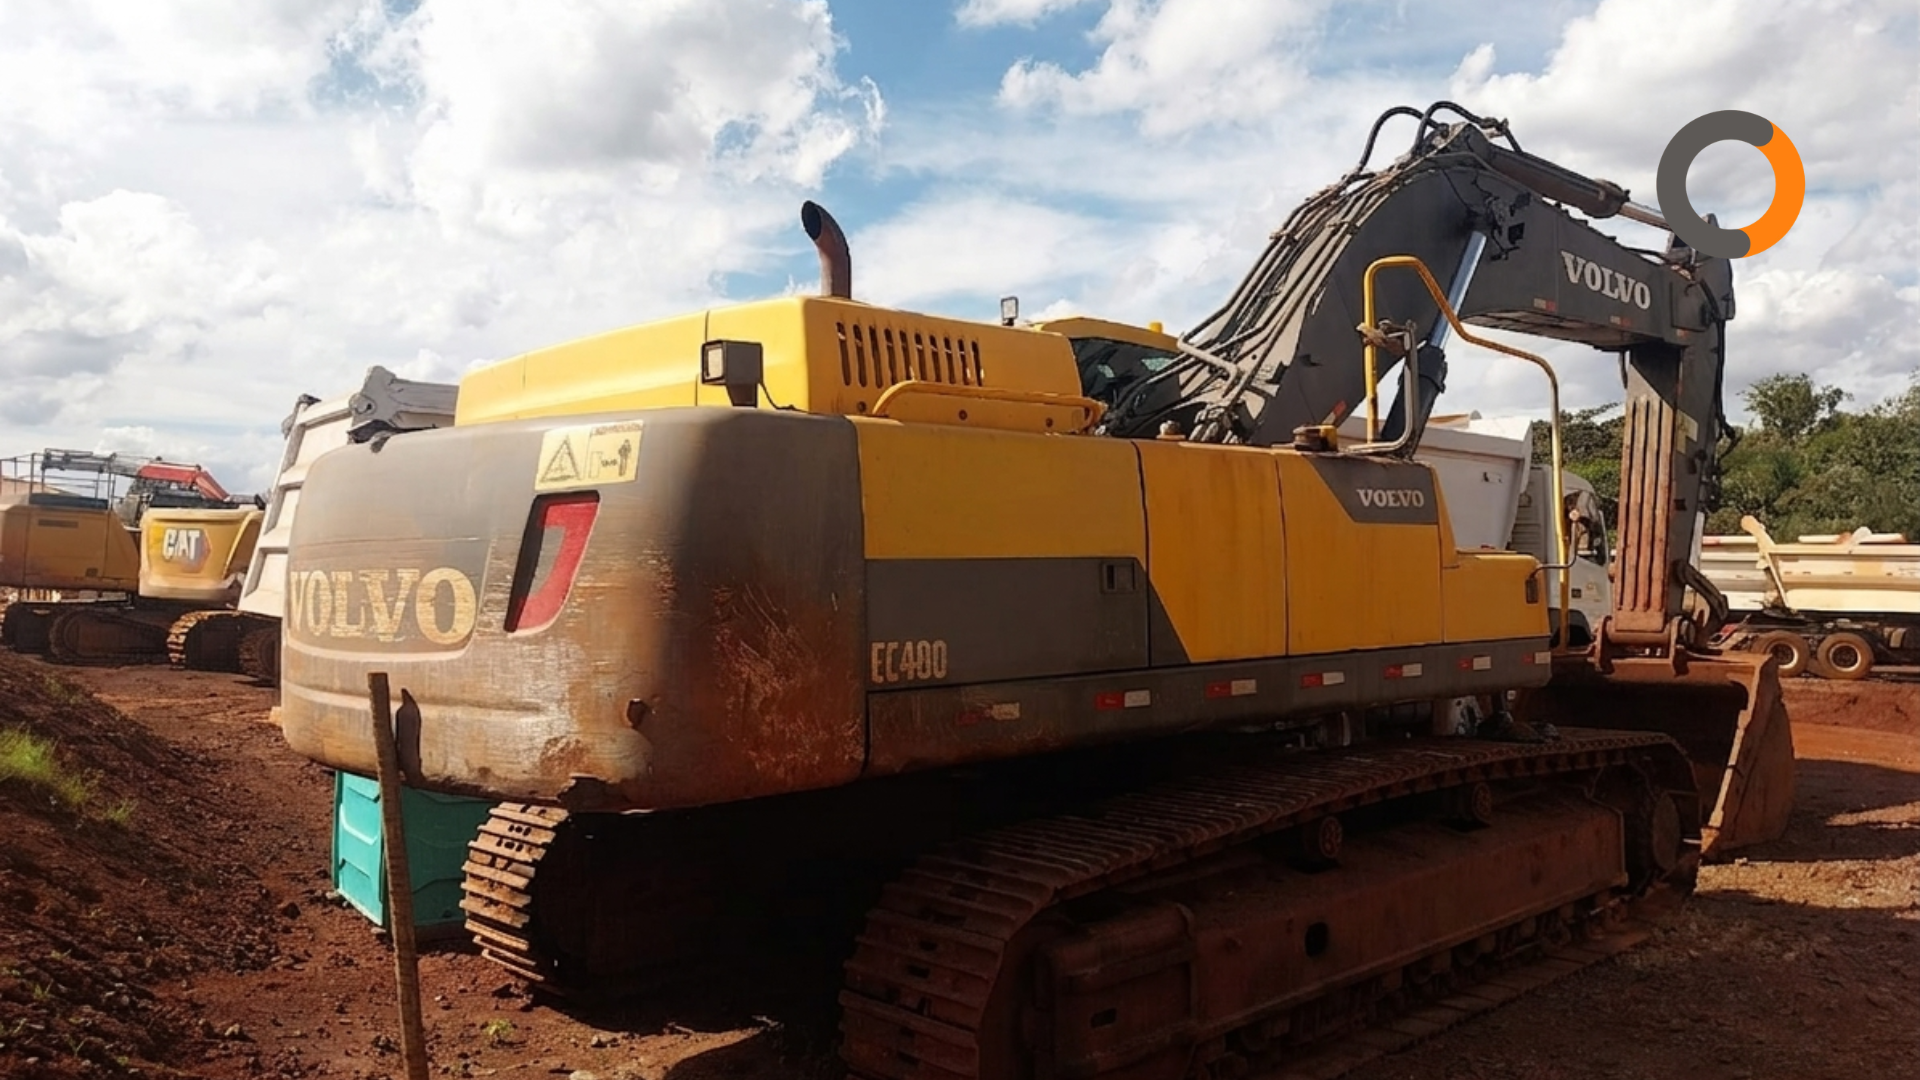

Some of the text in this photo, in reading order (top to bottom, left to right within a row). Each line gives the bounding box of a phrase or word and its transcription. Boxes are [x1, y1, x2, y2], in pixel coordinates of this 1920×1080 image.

[1561, 250, 1651, 310] VOLVO
[163, 528, 200, 560] CAT
[291, 567, 477, 645] VOLVO
